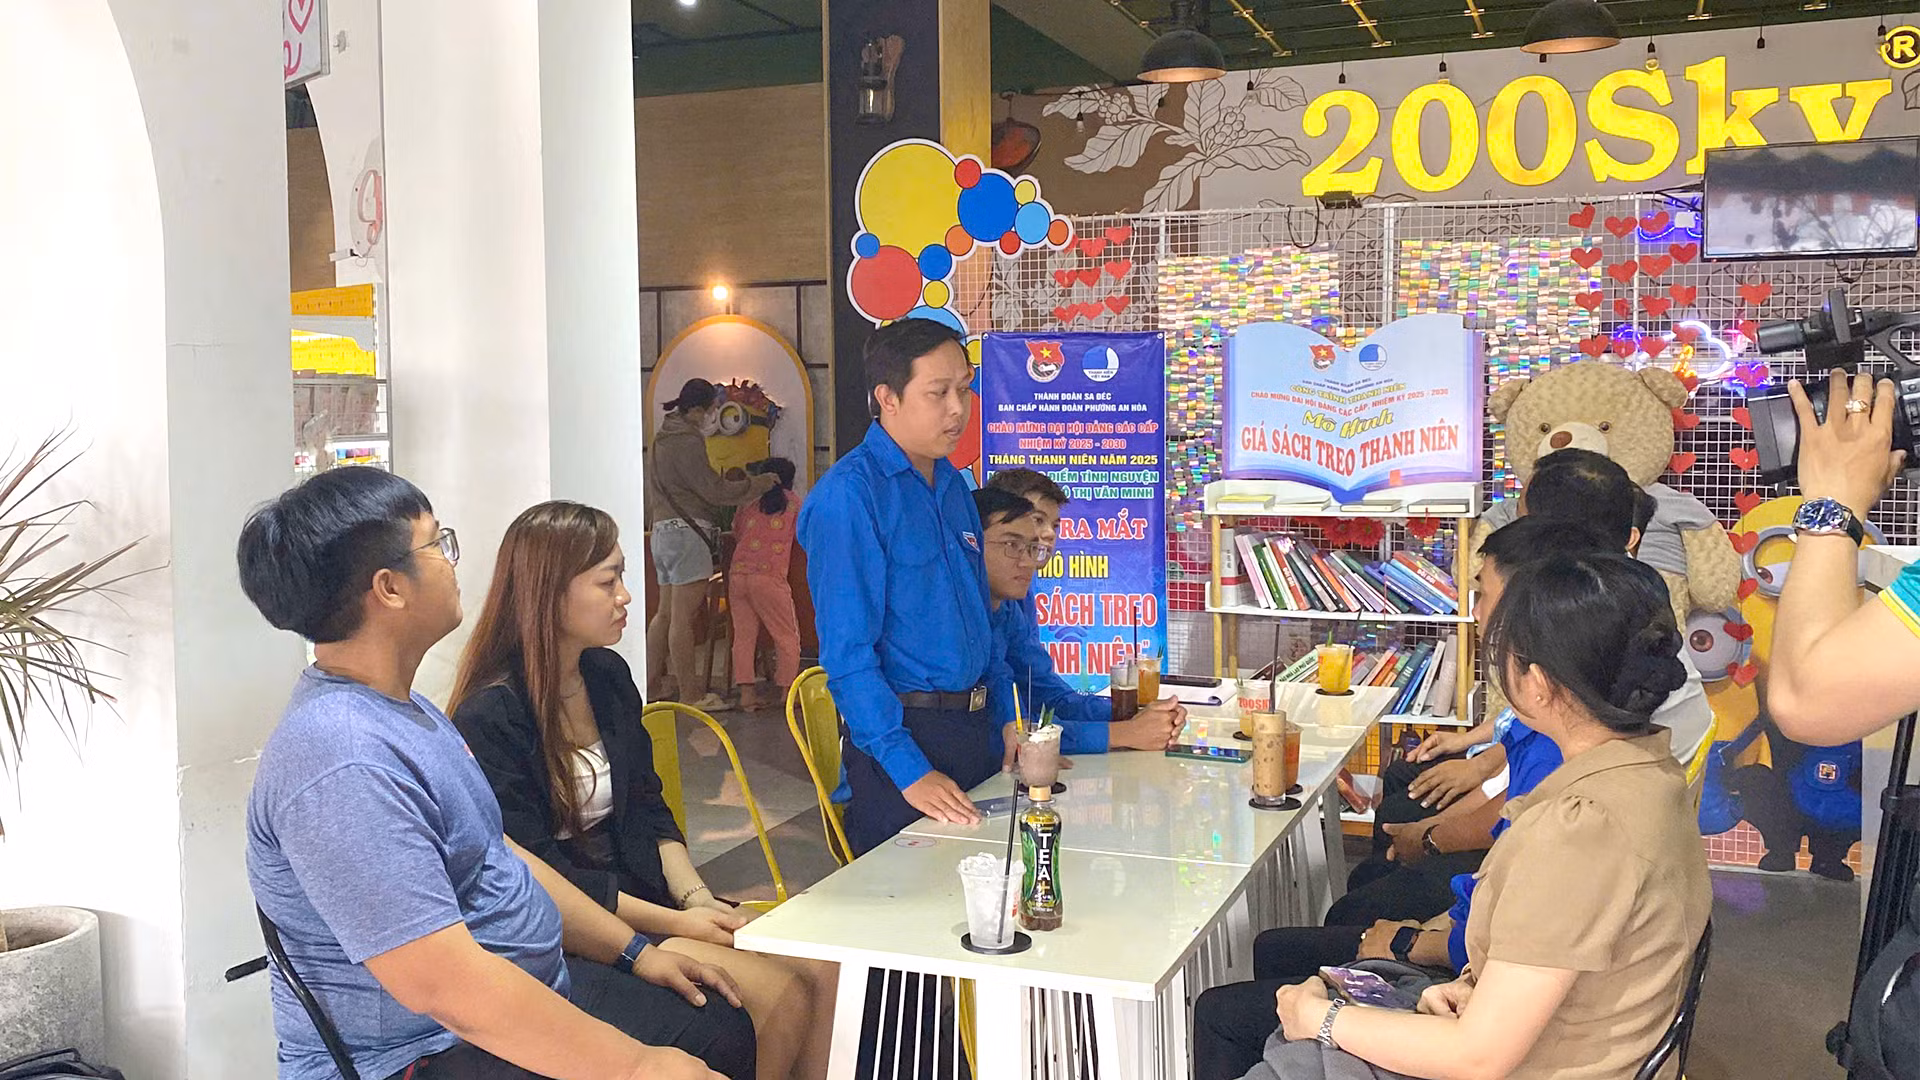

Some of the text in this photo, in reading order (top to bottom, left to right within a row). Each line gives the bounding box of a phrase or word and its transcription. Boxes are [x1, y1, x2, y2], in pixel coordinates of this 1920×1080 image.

[1034, 392, 1060, 401] THÀNH
[1061, 392, 1083, 401] ĐOÀN
[1084, 393, 1095, 401] SA
[1407, 390, 1425, 400] 2025
[1431, 387, 1449, 397] 2030
[998, 404, 1015, 412] BAN
[1016, 403, 1037, 412] CHẤP
[1039, 403, 1060, 412] HÀNH
[1062, 403, 1083, 412] ĐOÀN
[1118, 404, 1130, 412] AN
[1131, 403, 1148, 412] HÒA
[987, 422, 1014, 433] CHÀO
[1016, 421, 1046, 433] MỪNG
[1048, 423, 1065, 435] ĐẠI
[1067, 421, 1084, 435] HỘI
[1115, 421, 1136, 433] CÁC
[1138, 418, 1159, 433] CẤP
[1302, 408, 1394, 439] Mô Hình
[1019, 436, 1052, 451] NHIỆM
[1069, 439, 1093, 449] 2025
[1101, 439, 1127, 449] 2030
[1241, 417, 1460, 477] GIÁ SÁCH TREO THANH NIÊN
[989, 453, 1158, 465] THÁNG THANH NIÊN NĂM 2025
[1080, 470, 1110, 483] TÌNH
[1111, 470, 1160, 485] NGUYỆN
[1073, 487, 1092, 500] THỊ
[1120, 487, 1154, 499] MINH
[1059, 508, 1148, 539] RA MẮT
[1037, 551, 1109, 578] MÔ HÌNH
[1034, 587, 1158, 627] SÁCH TREO
